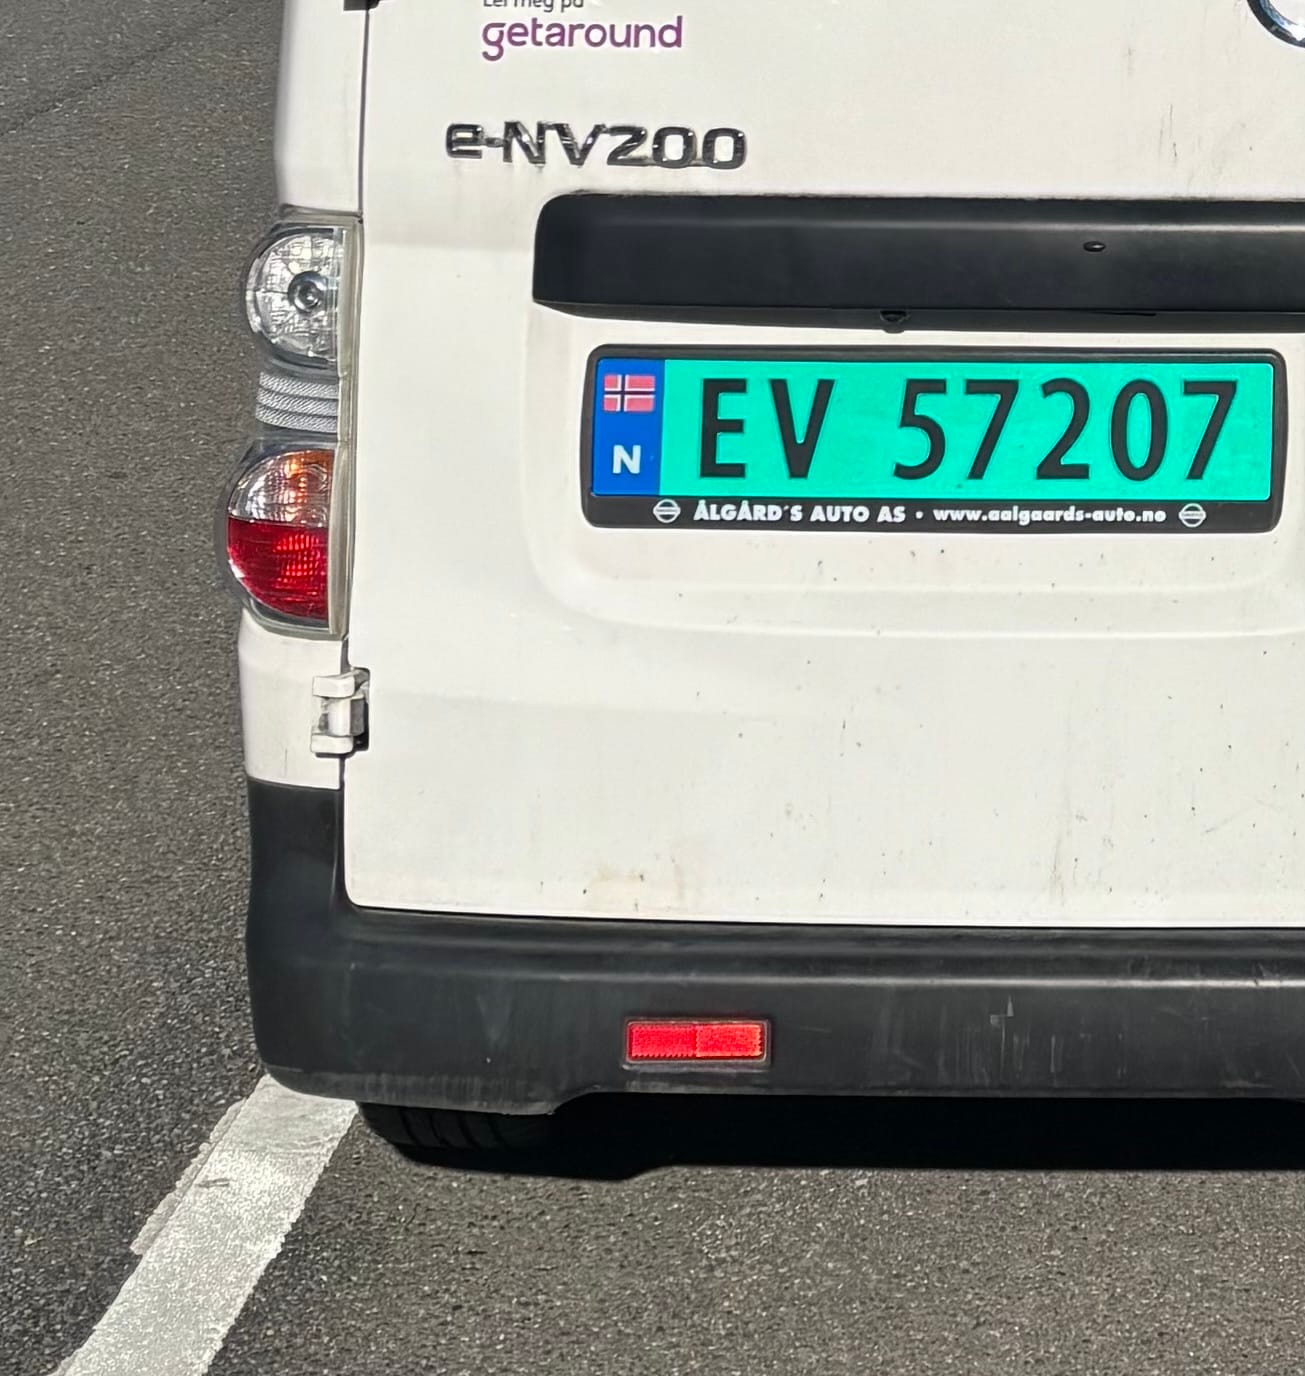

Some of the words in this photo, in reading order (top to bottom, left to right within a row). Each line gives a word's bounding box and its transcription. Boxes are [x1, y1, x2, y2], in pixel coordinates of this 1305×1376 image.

[481, 15, 684, 62] getaround
[445, 120, 747, 170] e-NV200
[700, 378, 836, 480] EV
[892, 377, 1239, 482] 572207
[612, 444, 642, 474] N
[809, 504, 871, 523] AUTO
[876, 505, 907, 524] AS
[933, 505, 1167, 526] www.aalgaards-auto.no
